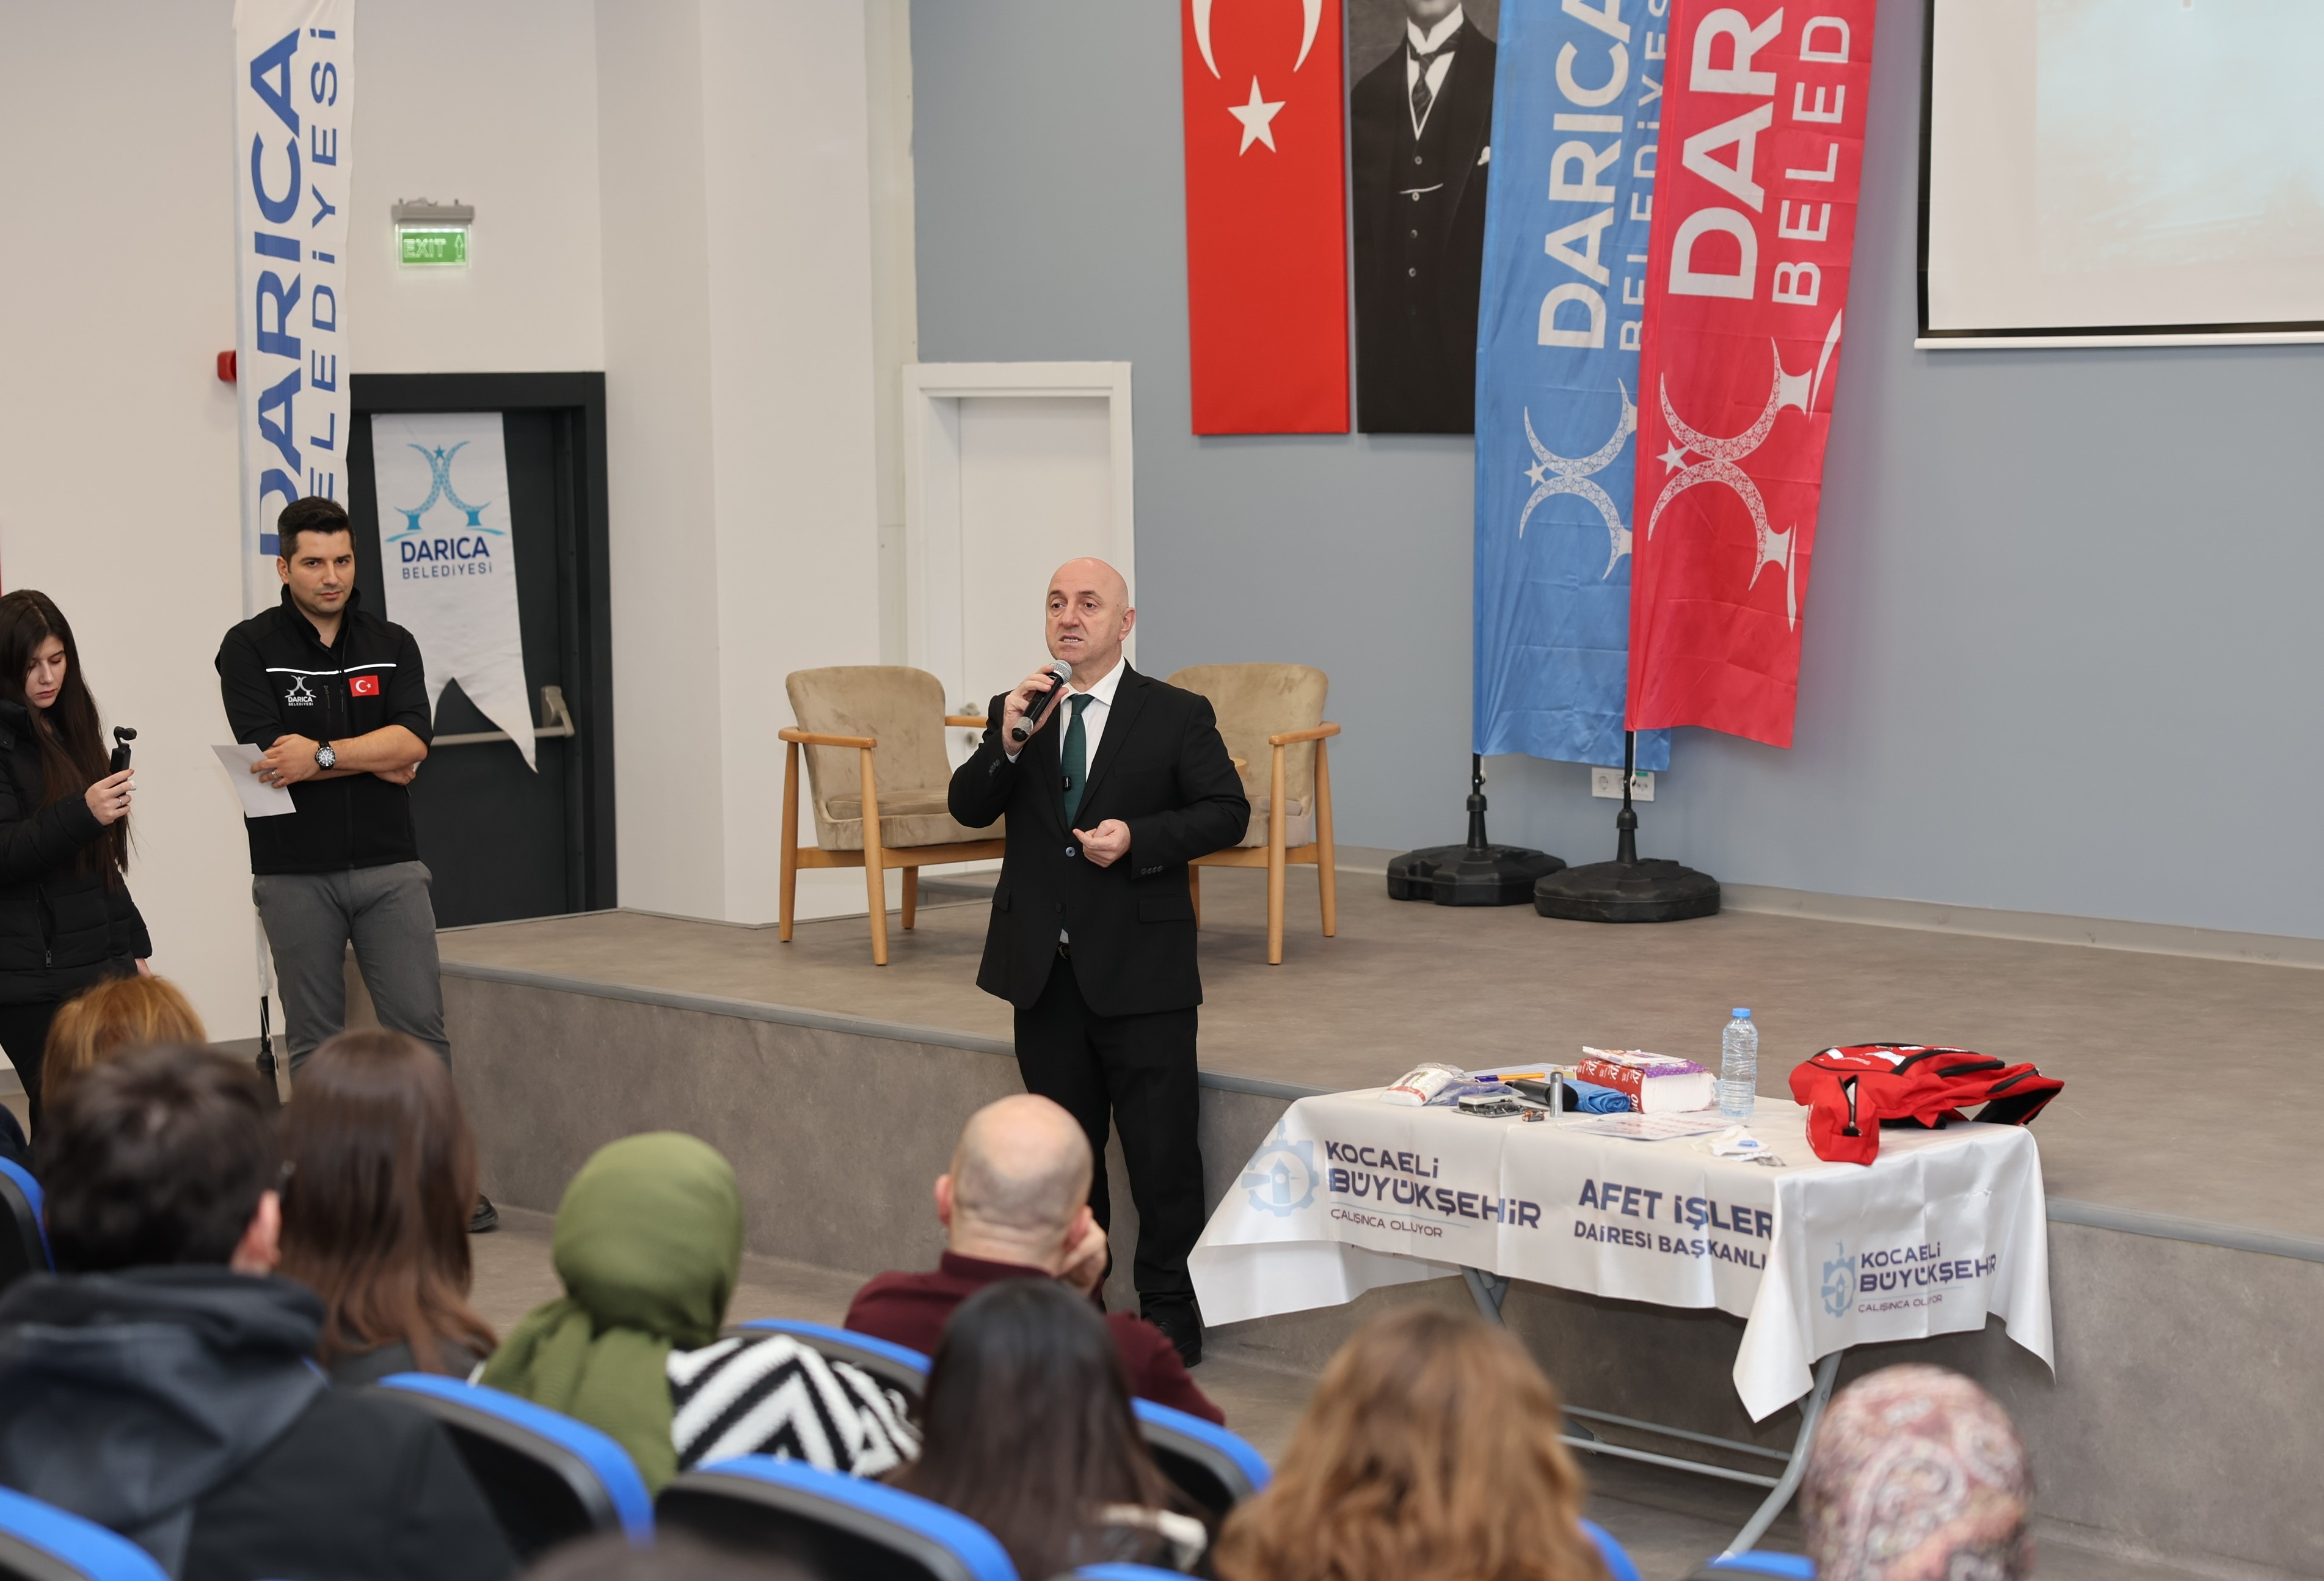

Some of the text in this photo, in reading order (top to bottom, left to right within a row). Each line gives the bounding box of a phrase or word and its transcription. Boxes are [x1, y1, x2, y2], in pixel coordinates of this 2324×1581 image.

[1668, 6, 1784, 300] DAR
[1772, 15, 1851, 306] BELED
[403, 238, 446, 258] EXIT
[250, 27, 301, 556] DARICA
[401, 536, 490, 563] DARICA
[1578, 1178, 1663, 1219] AFET
[1330, 1208, 1443, 1238] ÇALIŞINCA OLUYOR
